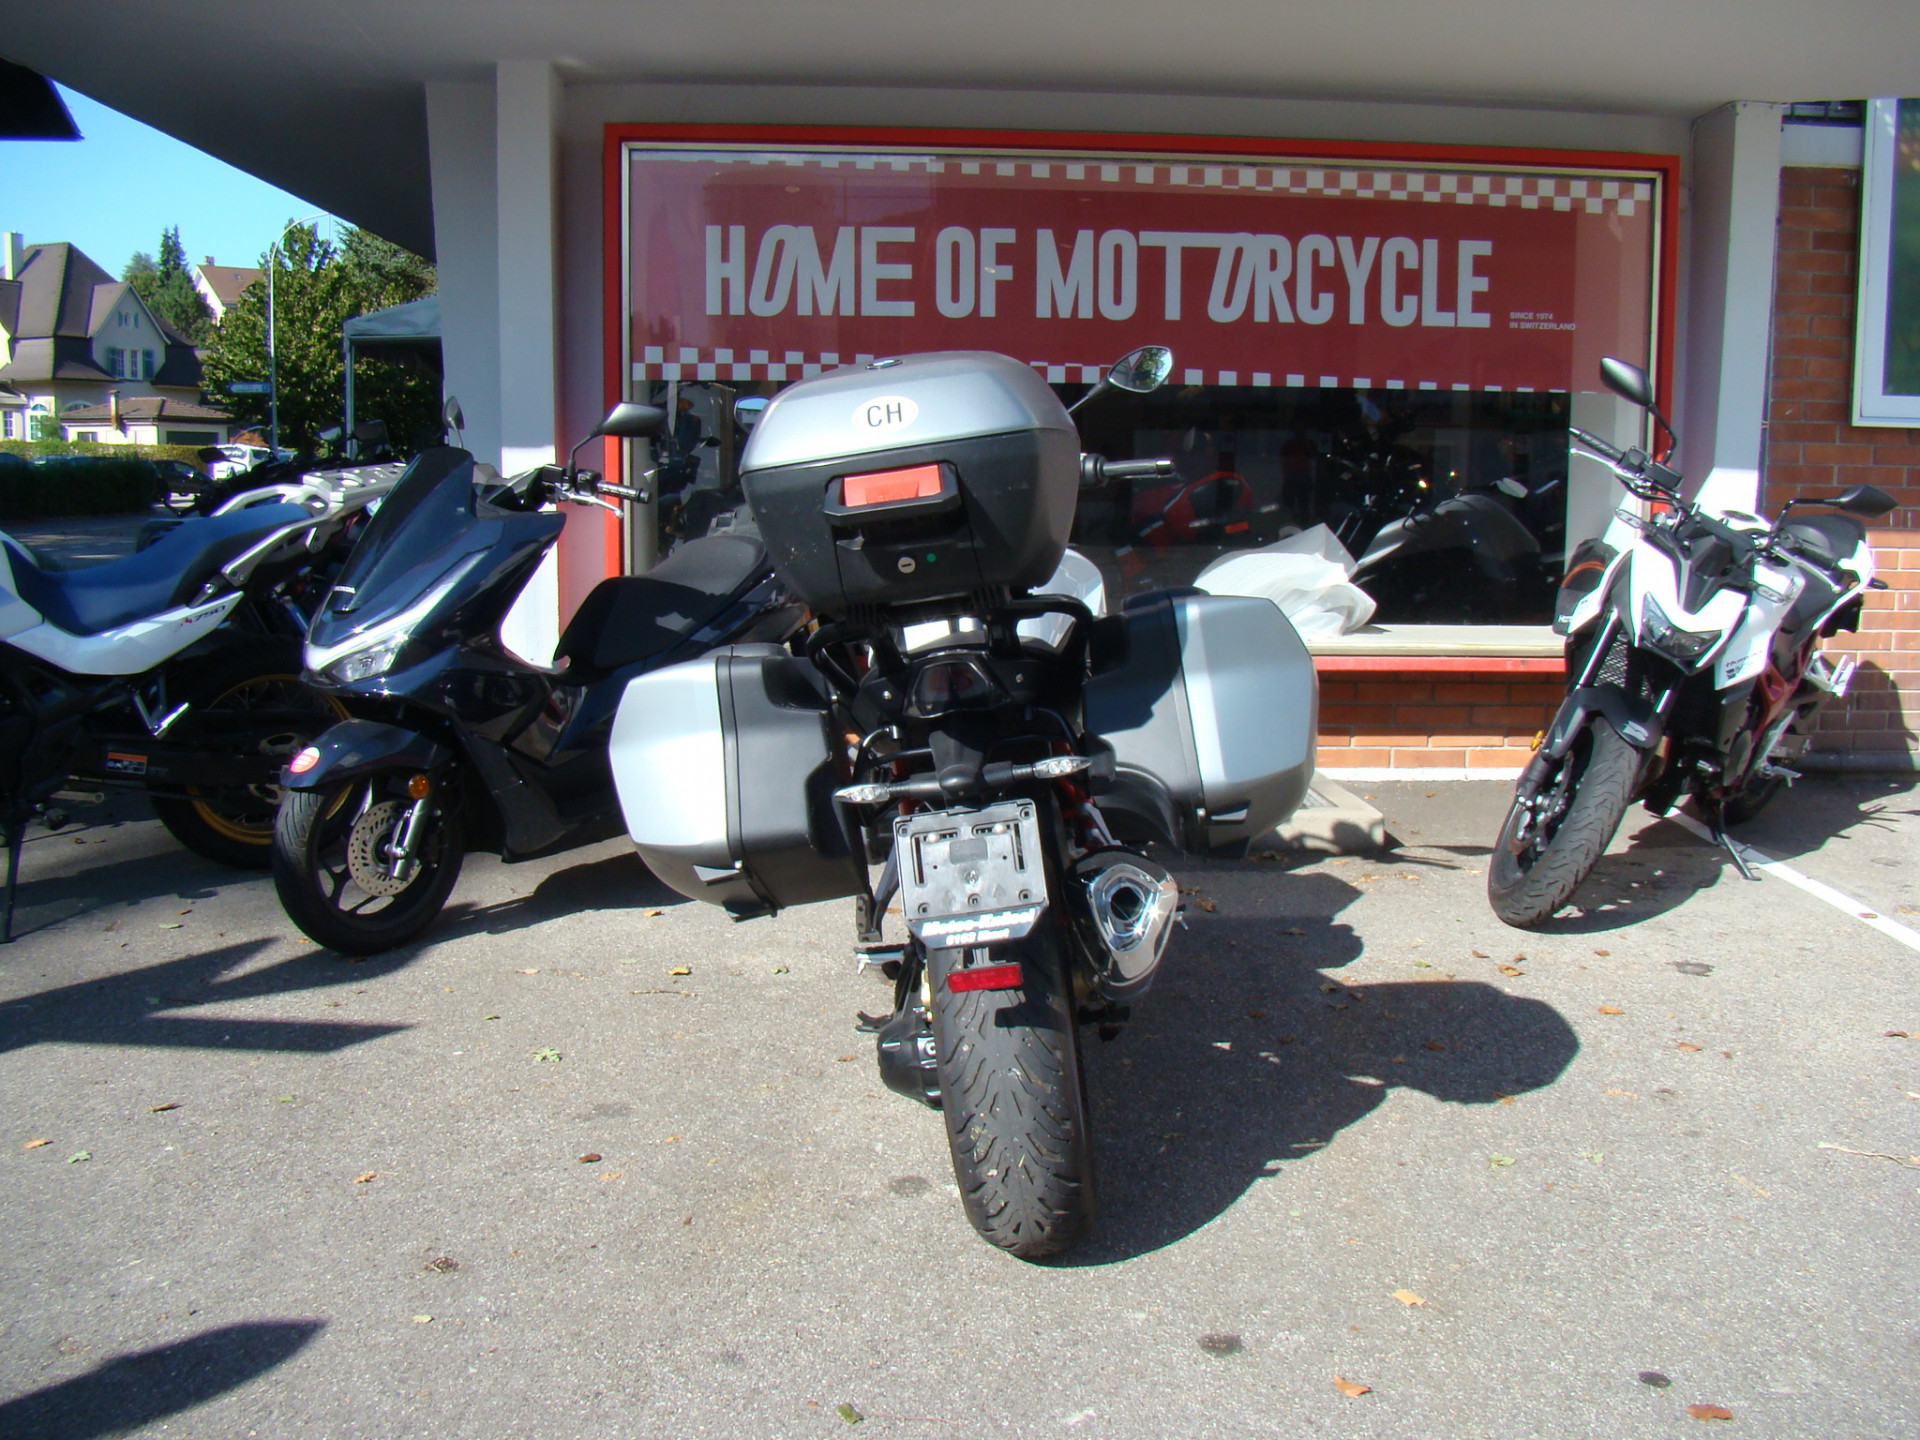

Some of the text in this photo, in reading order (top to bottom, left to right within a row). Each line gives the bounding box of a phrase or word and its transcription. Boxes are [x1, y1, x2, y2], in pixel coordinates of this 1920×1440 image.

[705, 224, 1493, 328] HOME OF MOTORCYCLE
[1509, 312, 1534, 320] SINCE
[1509, 321, 1576, 331] IN SWITZERLAND
[867, 402, 902, 427] CH
